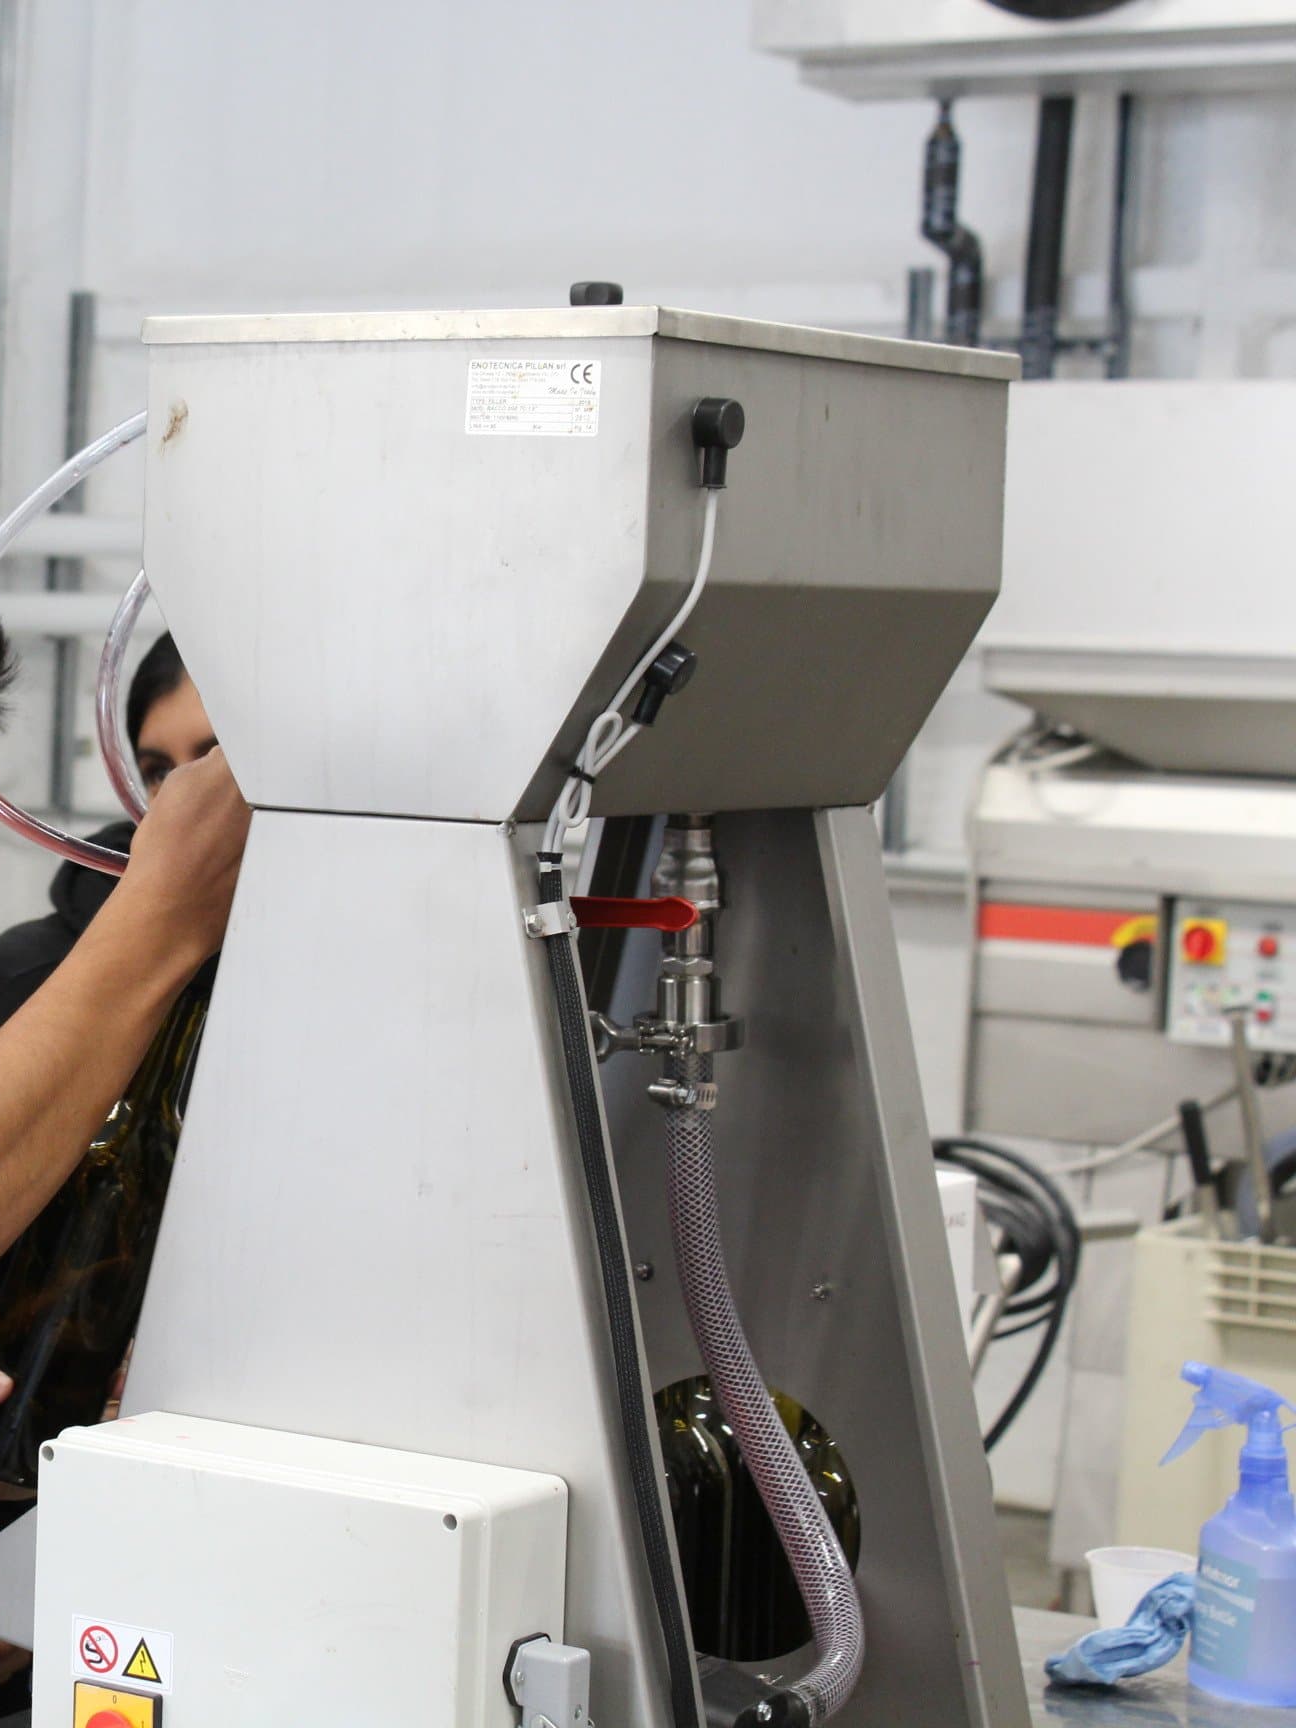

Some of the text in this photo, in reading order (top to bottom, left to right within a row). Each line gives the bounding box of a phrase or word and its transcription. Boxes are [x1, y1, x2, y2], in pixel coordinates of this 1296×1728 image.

[471, 361, 523, 370] ENOTECNICA
[525, 361, 554, 370] PILLAN
[570, 363, 594, 385] CE
